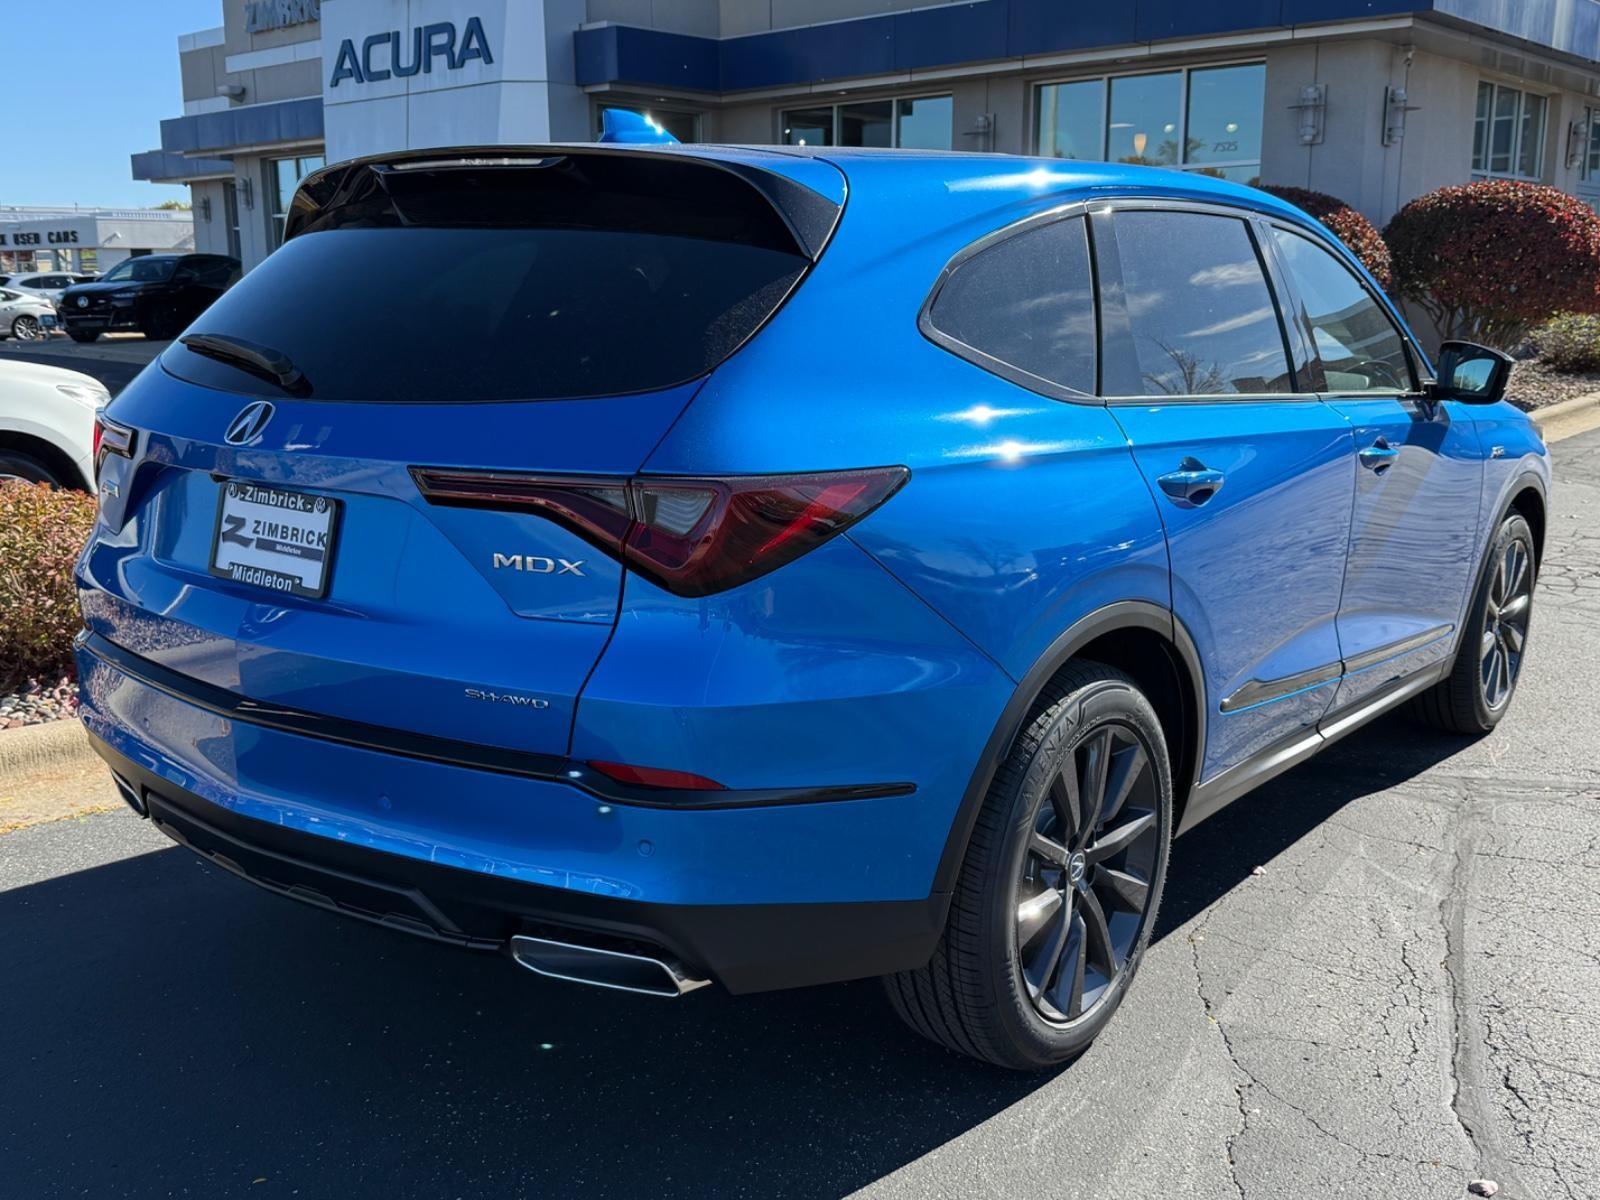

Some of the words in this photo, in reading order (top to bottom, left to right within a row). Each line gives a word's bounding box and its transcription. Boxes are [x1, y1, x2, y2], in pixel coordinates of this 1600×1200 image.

[329, 16, 494, 87] ACURA
[1213, 141, 1238, 152] 7525
[13, 232, 41, 245] USED
[48, 230, 79, 243] CARS
[244, 486, 305, 511] Zimbrick
[252, 520, 327, 548] ZIMBRICK
[493, 552, 586, 577] MDX
[232, 564, 293, 592] Middleton
